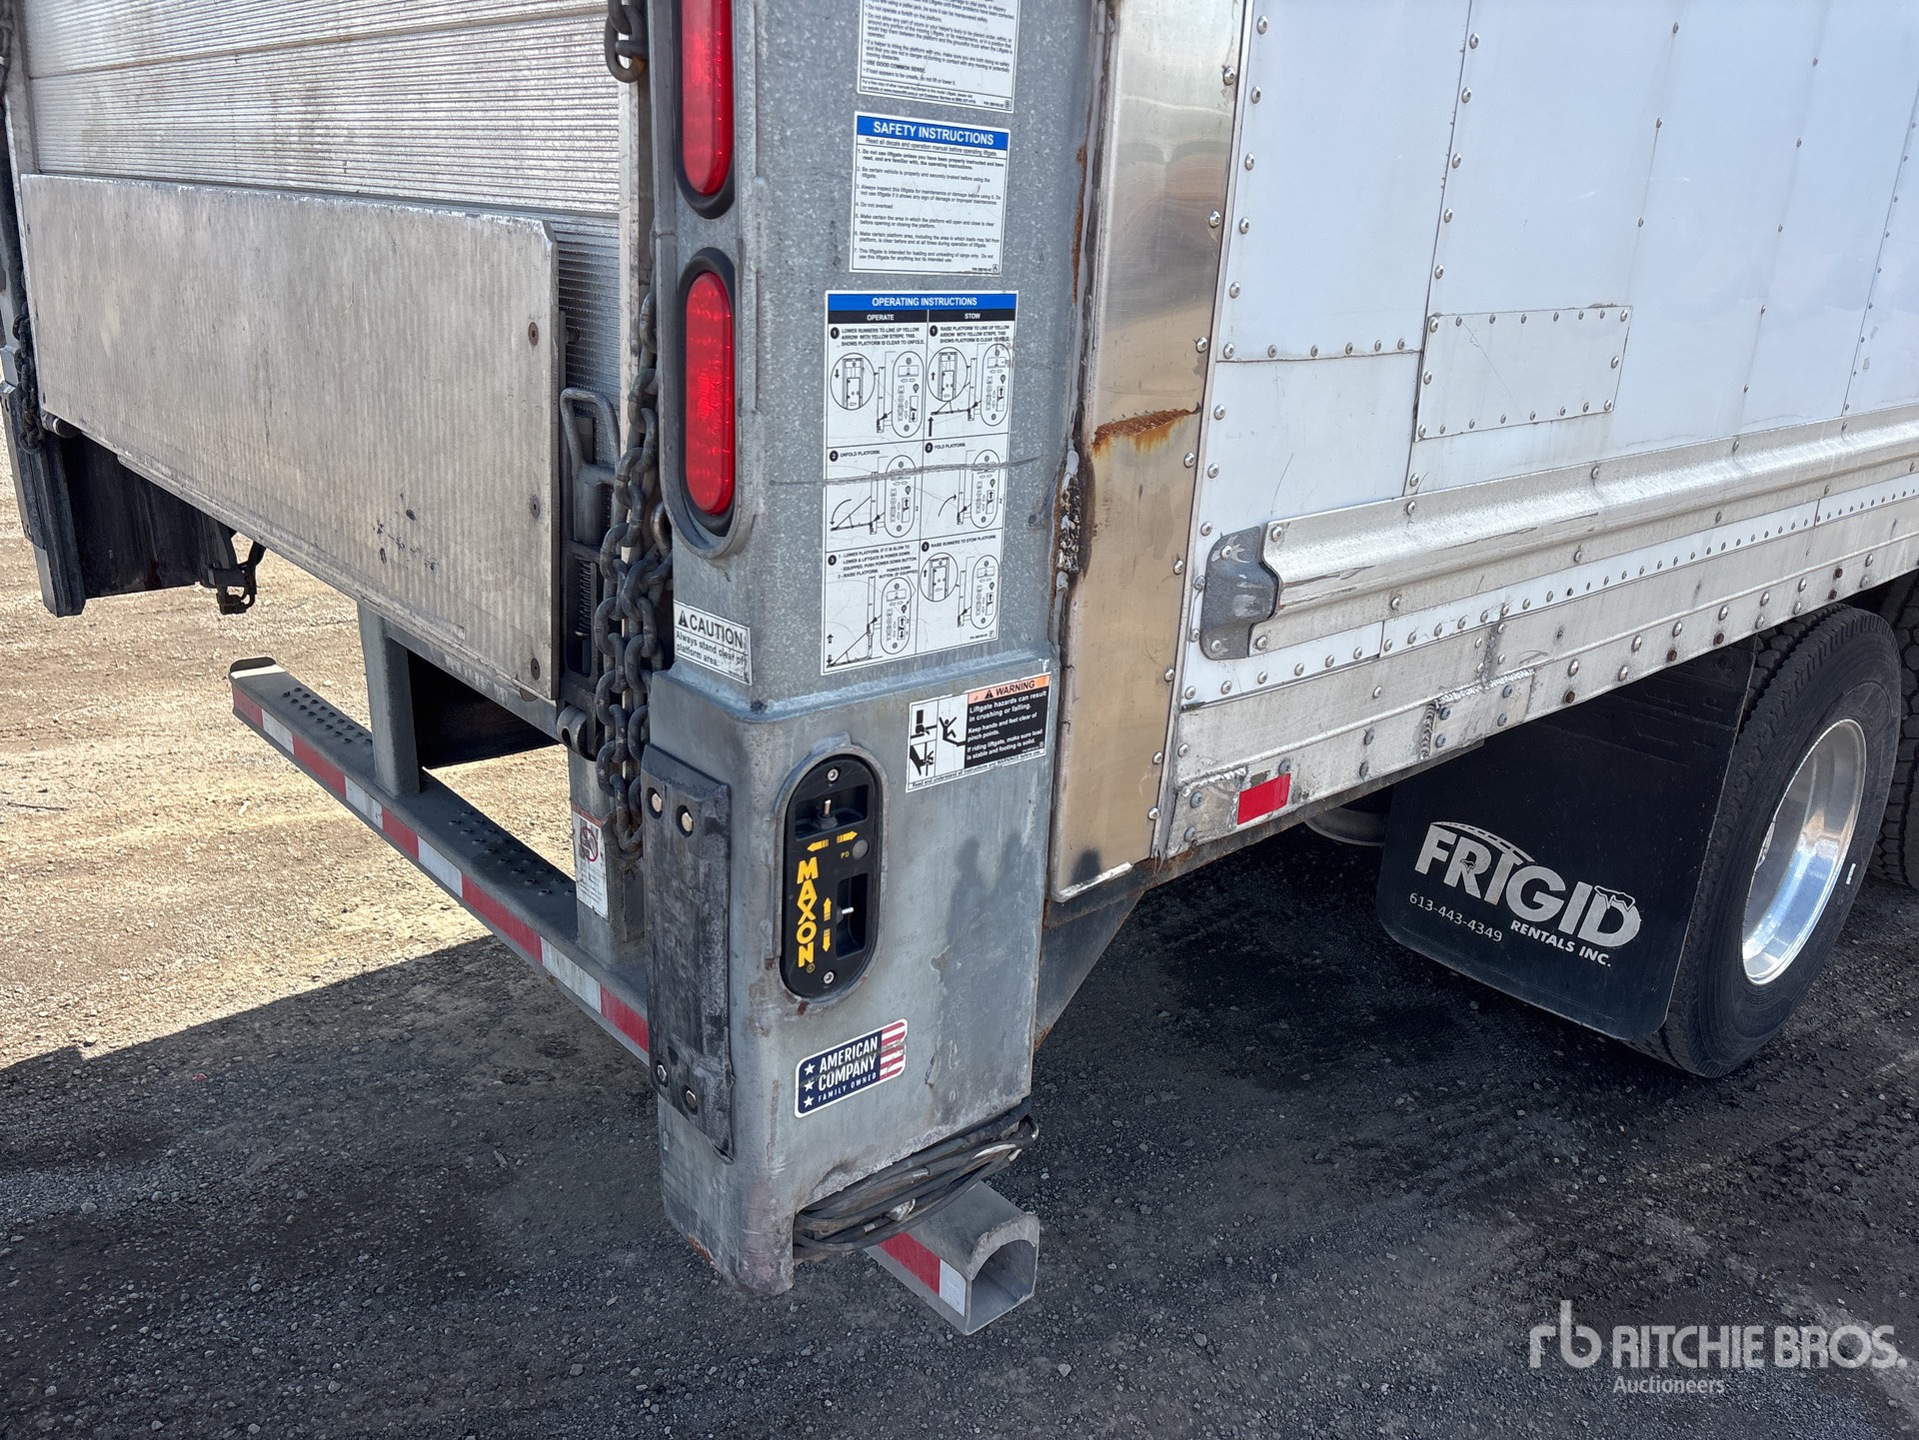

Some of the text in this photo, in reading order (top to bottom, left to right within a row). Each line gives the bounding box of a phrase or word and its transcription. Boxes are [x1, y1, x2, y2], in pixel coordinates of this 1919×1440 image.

[873, 121, 994, 146] SAFETY INSTRUCTIONS
[872, 298, 977, 307] OPERATING INSTRUCTIONS
[690, 614, 742, 648] CAUTION
[676, 630, 697, 646] Always
[699, 640, 716, 653] stand
[719, 648, 734, 660] clear
[676, 644, 719, 666] platform area.
[995, 680, 1035, 697] WARNING
[969, 703, 993, 715] Liftgate
[994, 697, 1017, 708] hazards
[1030, 690, 1047, 699] result
[976, 709, 1003, 722] crushing
[1011, 701, 1032, 713] falling.
[968, 711, 1037, 734] Keep hands and feet clear of
[968, 729, 1000, 743] pinch points.
[972, 743, 986, 752] riding
[987, 738, 1006, 749] liftgate,
[1006, 734, 1020, 742] make
[1032, 728, 1042, 736] load
[972, 750, 988, 759] stable
[989, 747, 998, 755] and
[999, 743, 1016, 753] footing
[1022, 738, 1036, 746] solid.
[840, 851, 849, 859] PD
[1414, 823, 1642, 947] FRIGID
[796, 857, 819, 967] MAXON
[1409, 892, 1503, 942] 613-443-4349
[1510, 920, 1612, 967] RENTALS INC.
[819, 1036, 878, 1073] AMERICAN
[818, 1052, 877, 1091] COMPANY
[818, 1072, 876, 1103] FAMILY OWNED
